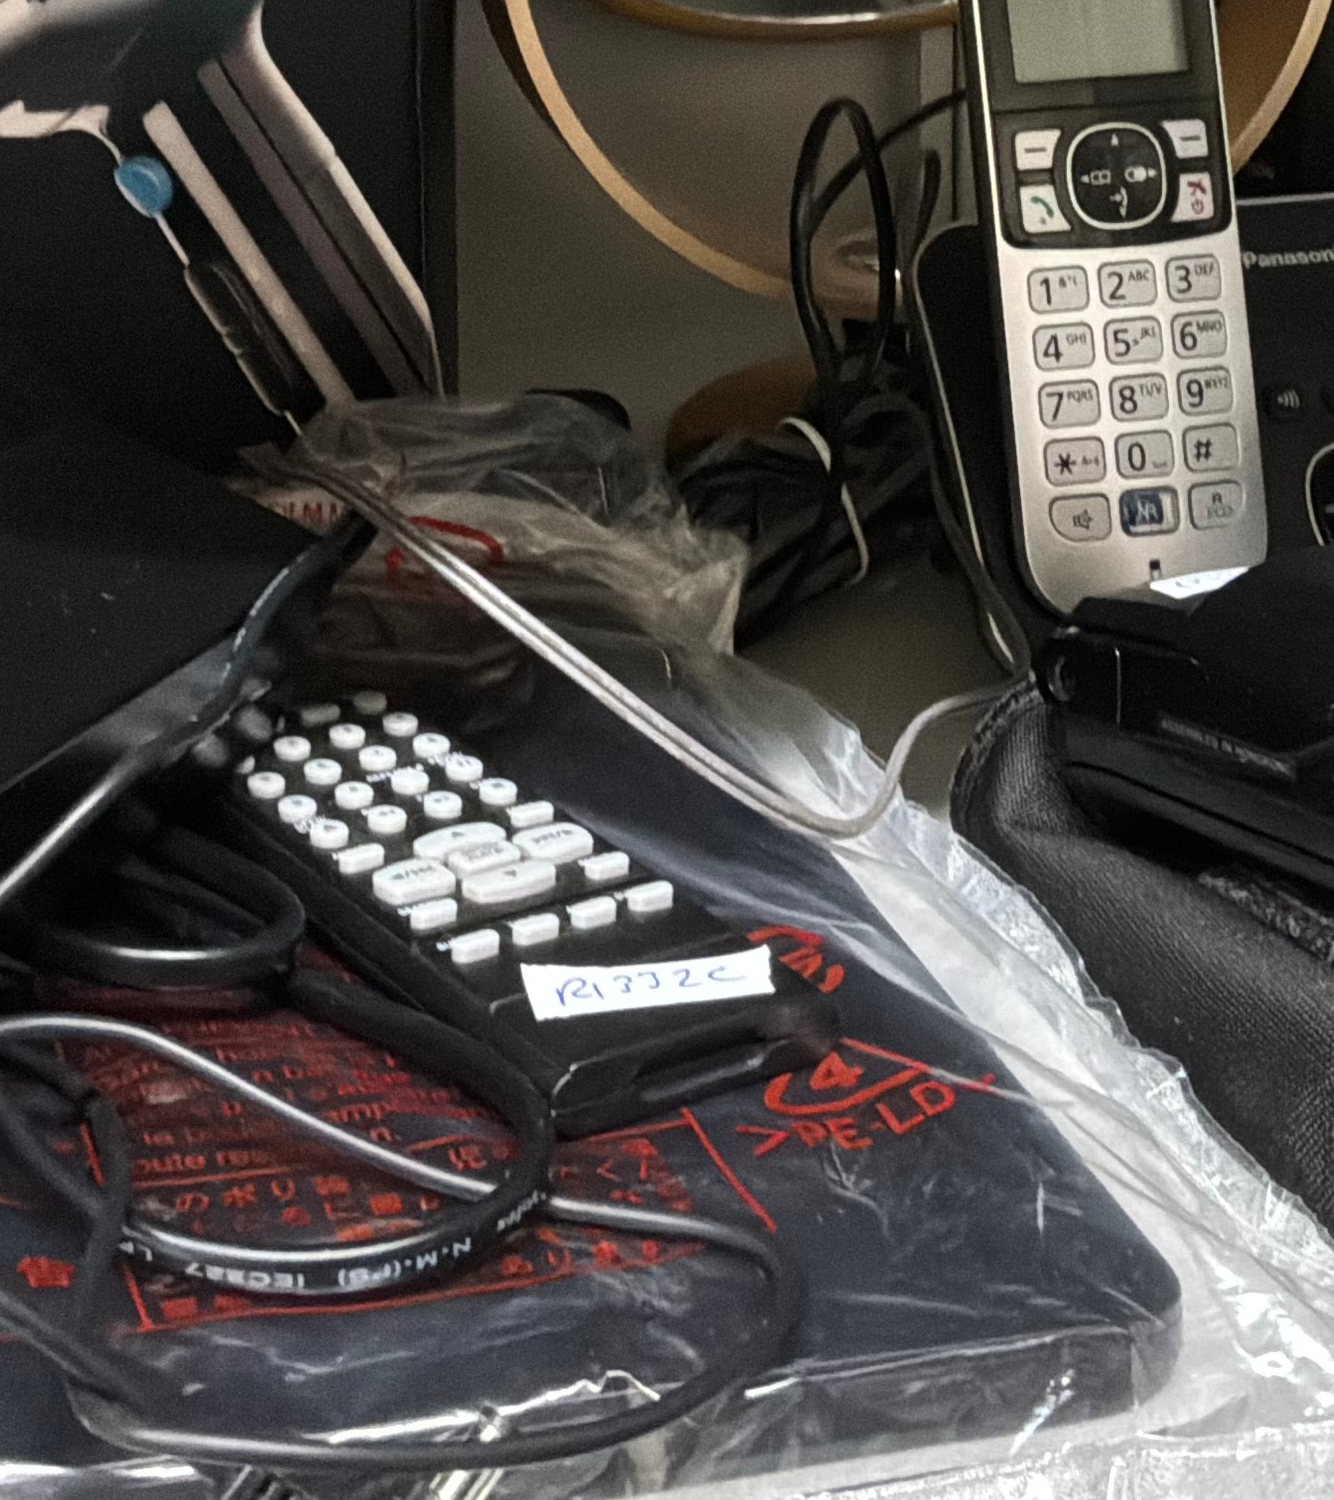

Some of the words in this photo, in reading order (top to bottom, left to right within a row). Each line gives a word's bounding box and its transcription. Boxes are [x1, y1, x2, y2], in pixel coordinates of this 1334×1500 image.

[1039, 276, 1053, 307] 1
[1106, 271, 1126, 301] 2
[1128, 269, 1150, 282] ABC
[1174, 264, 1193, 294] 3
[1042, 332, 1064, 363] 4
[1066, 332, 1088, 346] GHI
[1112, 328, 1132, 357] 5
[1178, 321, 1198, 351] 6
[1045, 391, 1064, 422] 7
[1117, 384, 1138, 415] 8
[1185, 378, 1205, 408] 9
[1126, 441, 1147, 472] 0
